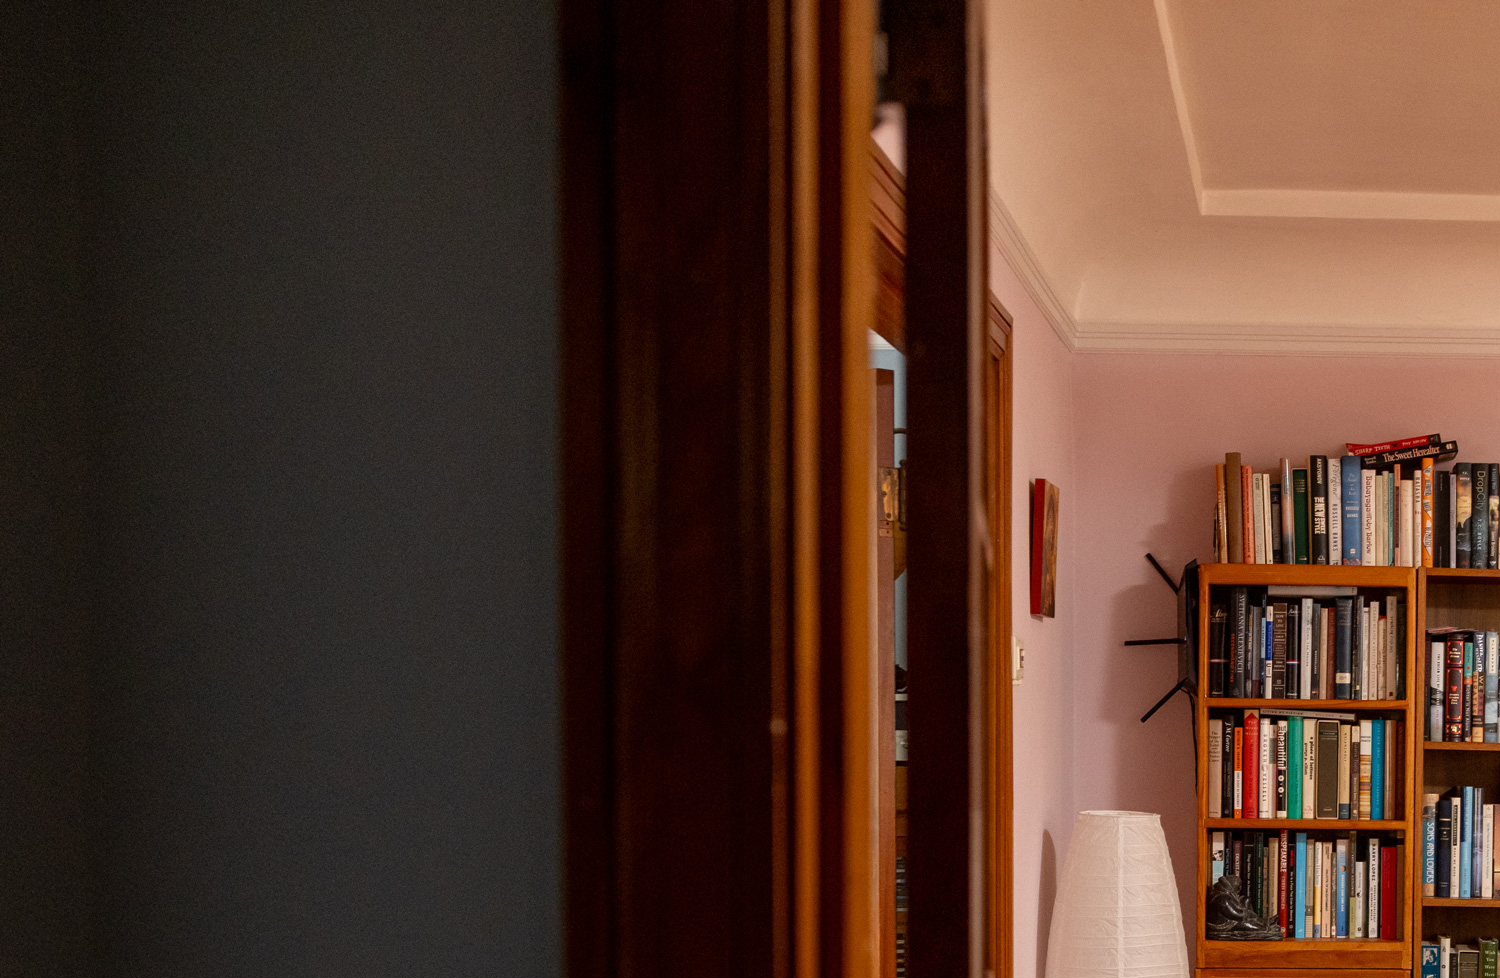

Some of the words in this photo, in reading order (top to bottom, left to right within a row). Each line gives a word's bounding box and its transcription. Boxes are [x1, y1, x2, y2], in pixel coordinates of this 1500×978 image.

[1382, 453, 1394, 462] The
[1394, 450, 1412, 461] Sweet
[1412, 446, 1440, 458] Hereafter
[1331, 463, 1340, 496] Foregone
[1365, 475, 1373, 512] Babayaga
[1314, 503, 1325, 518] NEW
[1479, 675, 1484, 691] WE
[1278, 731, 1286, 770] beautiful
[1426, 822, 1434, 841] SONS
[1426, 842, 1434, 857] AND
[1426, 857, 1434, 884] LOVERS
